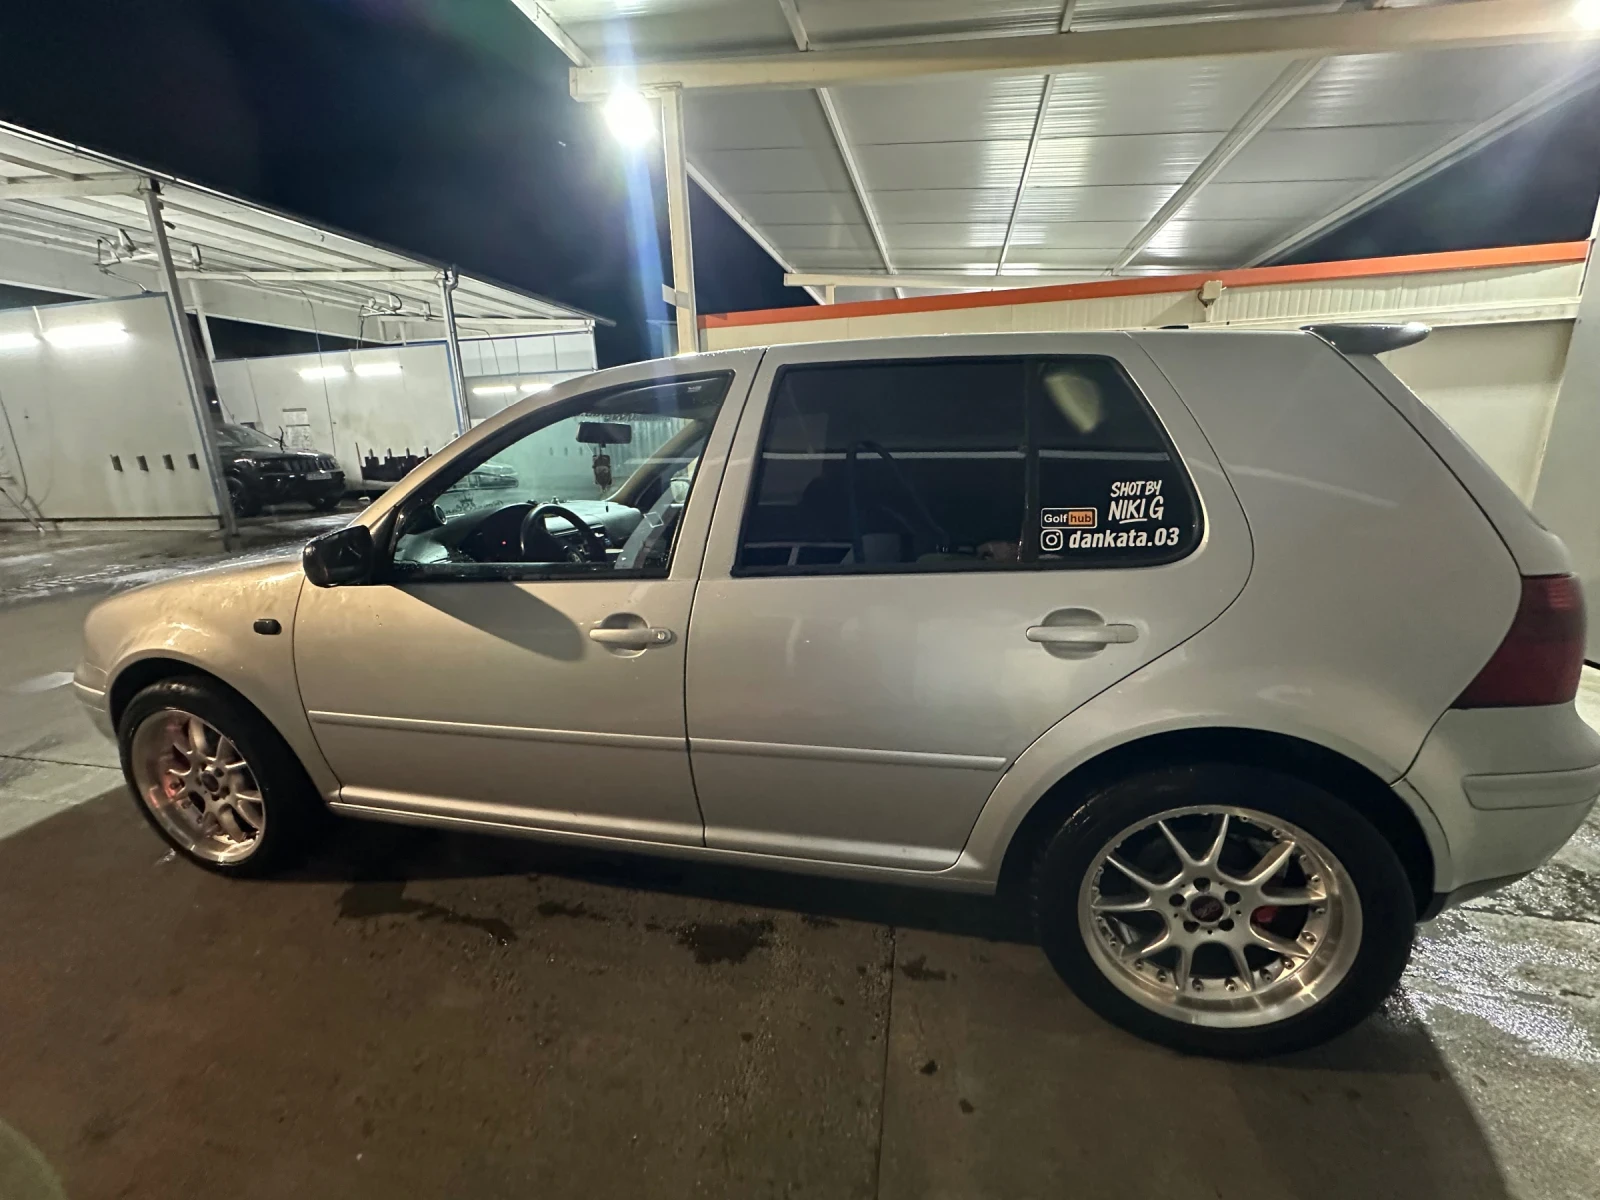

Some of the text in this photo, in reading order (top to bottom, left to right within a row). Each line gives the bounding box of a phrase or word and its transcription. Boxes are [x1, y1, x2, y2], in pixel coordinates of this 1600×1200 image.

[1110, 480, 1162, 497] SHOT BY
[1108, 496, 1164, 521] NIKI G
[1069, 527, 1180, 548] dankata.03
